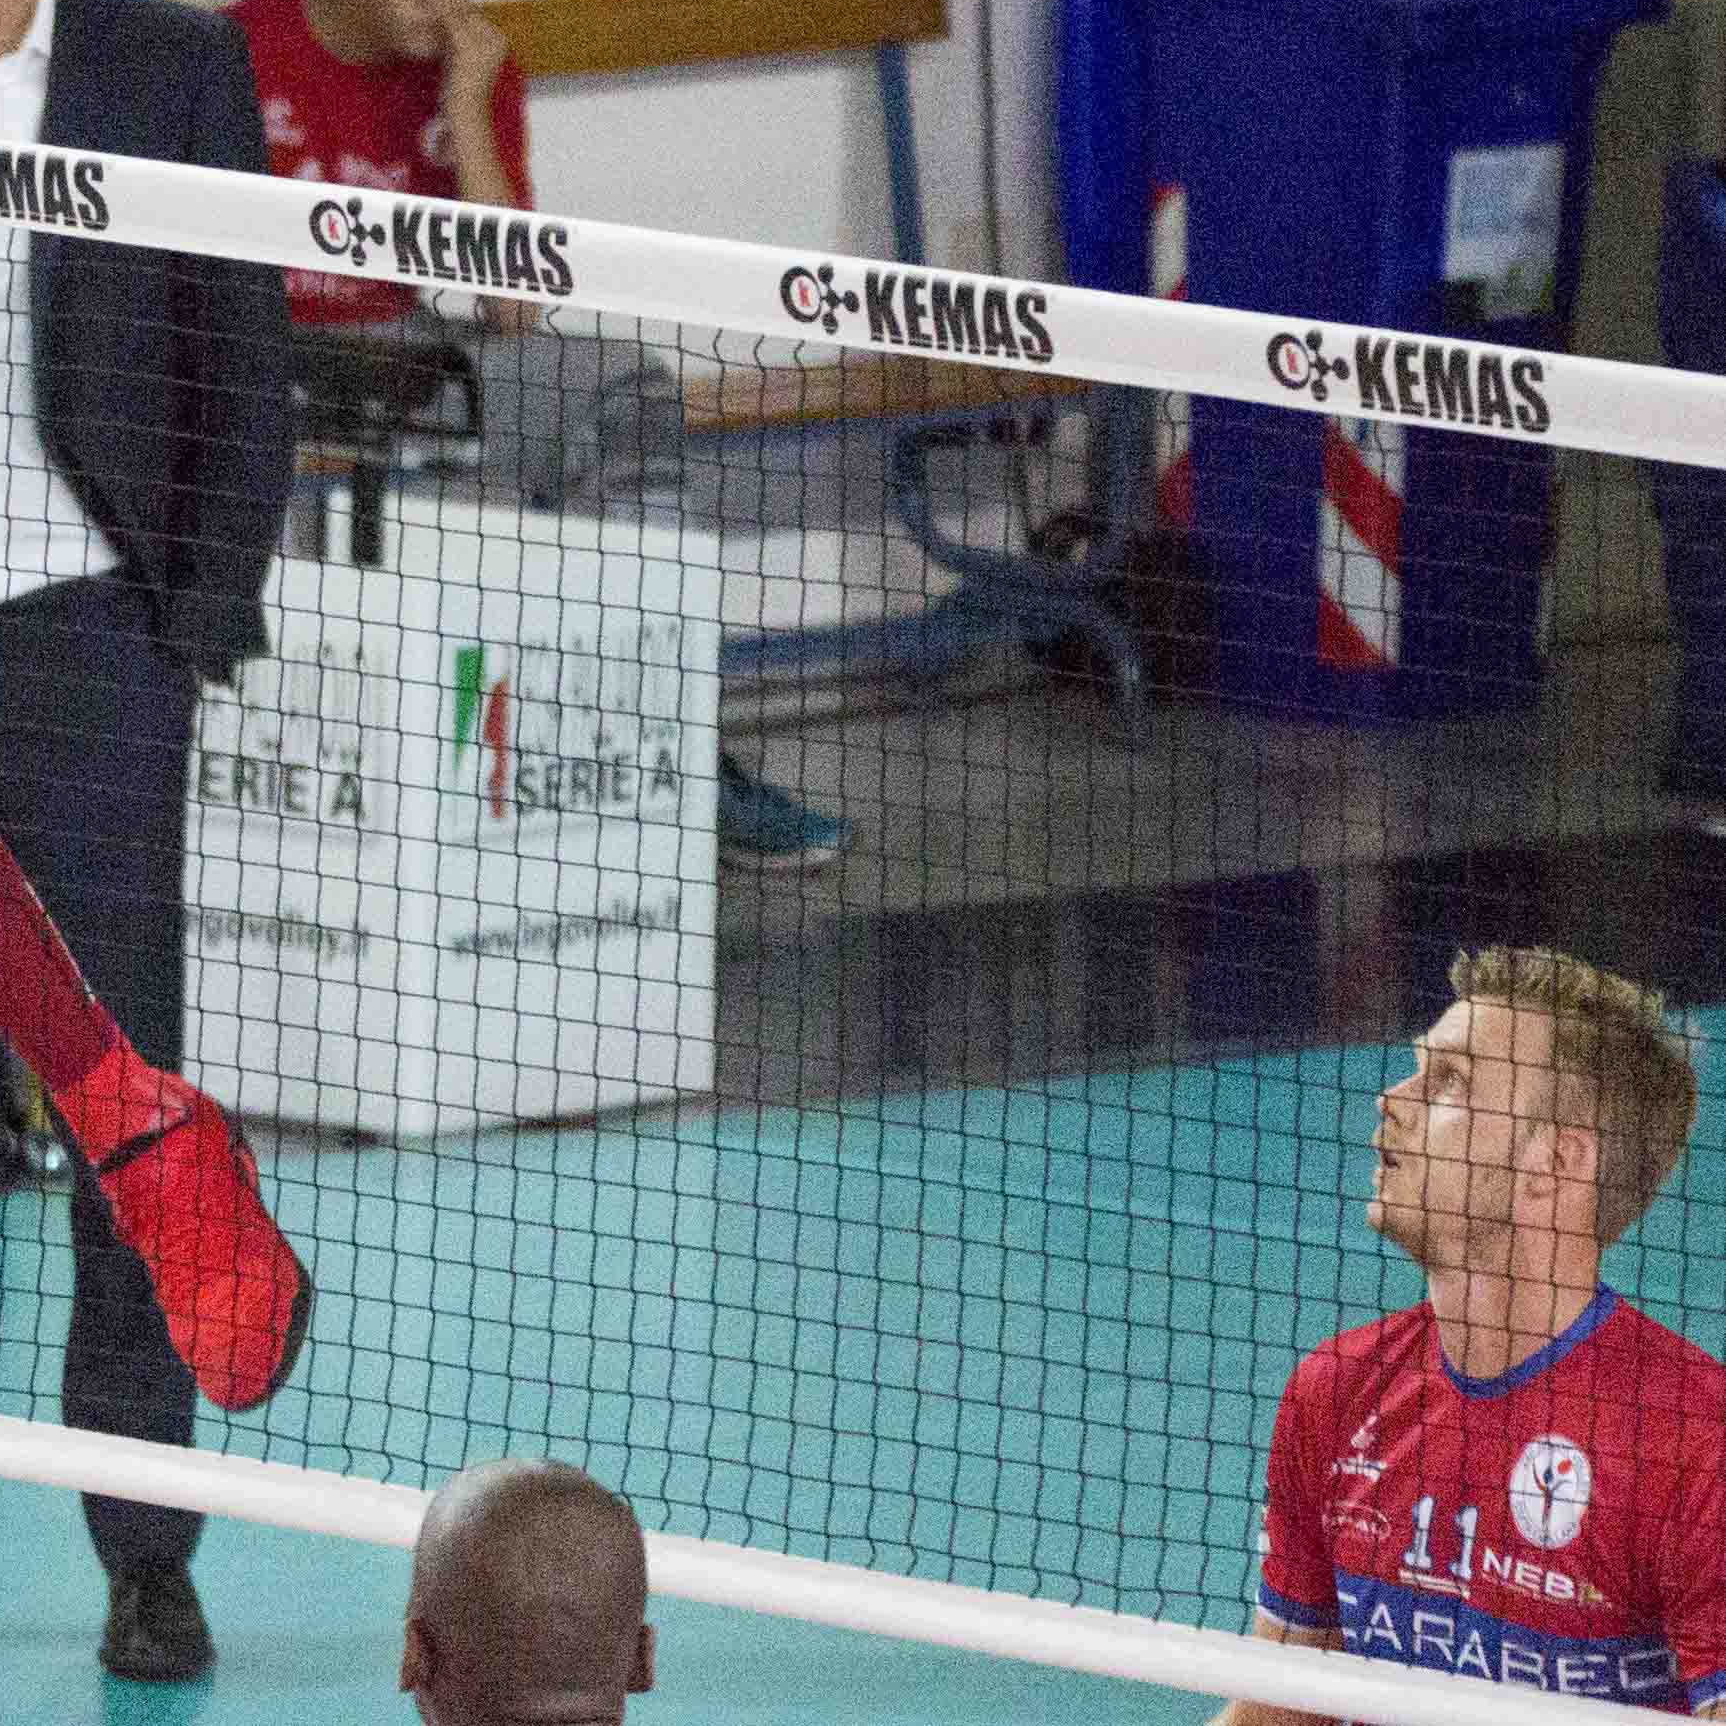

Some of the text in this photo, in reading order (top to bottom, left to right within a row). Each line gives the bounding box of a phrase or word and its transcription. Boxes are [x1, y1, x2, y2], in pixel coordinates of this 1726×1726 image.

[391, 199, 574, 297] KEMAS
[864, 268, 1055, 365] KEMAS
[1353, 333, 1551, 434] KEMAS
[198, 750, 367, 821] ERIE A
[650, 746, 679, 795] A
[1402, 1495, 1479, 1580] 11
